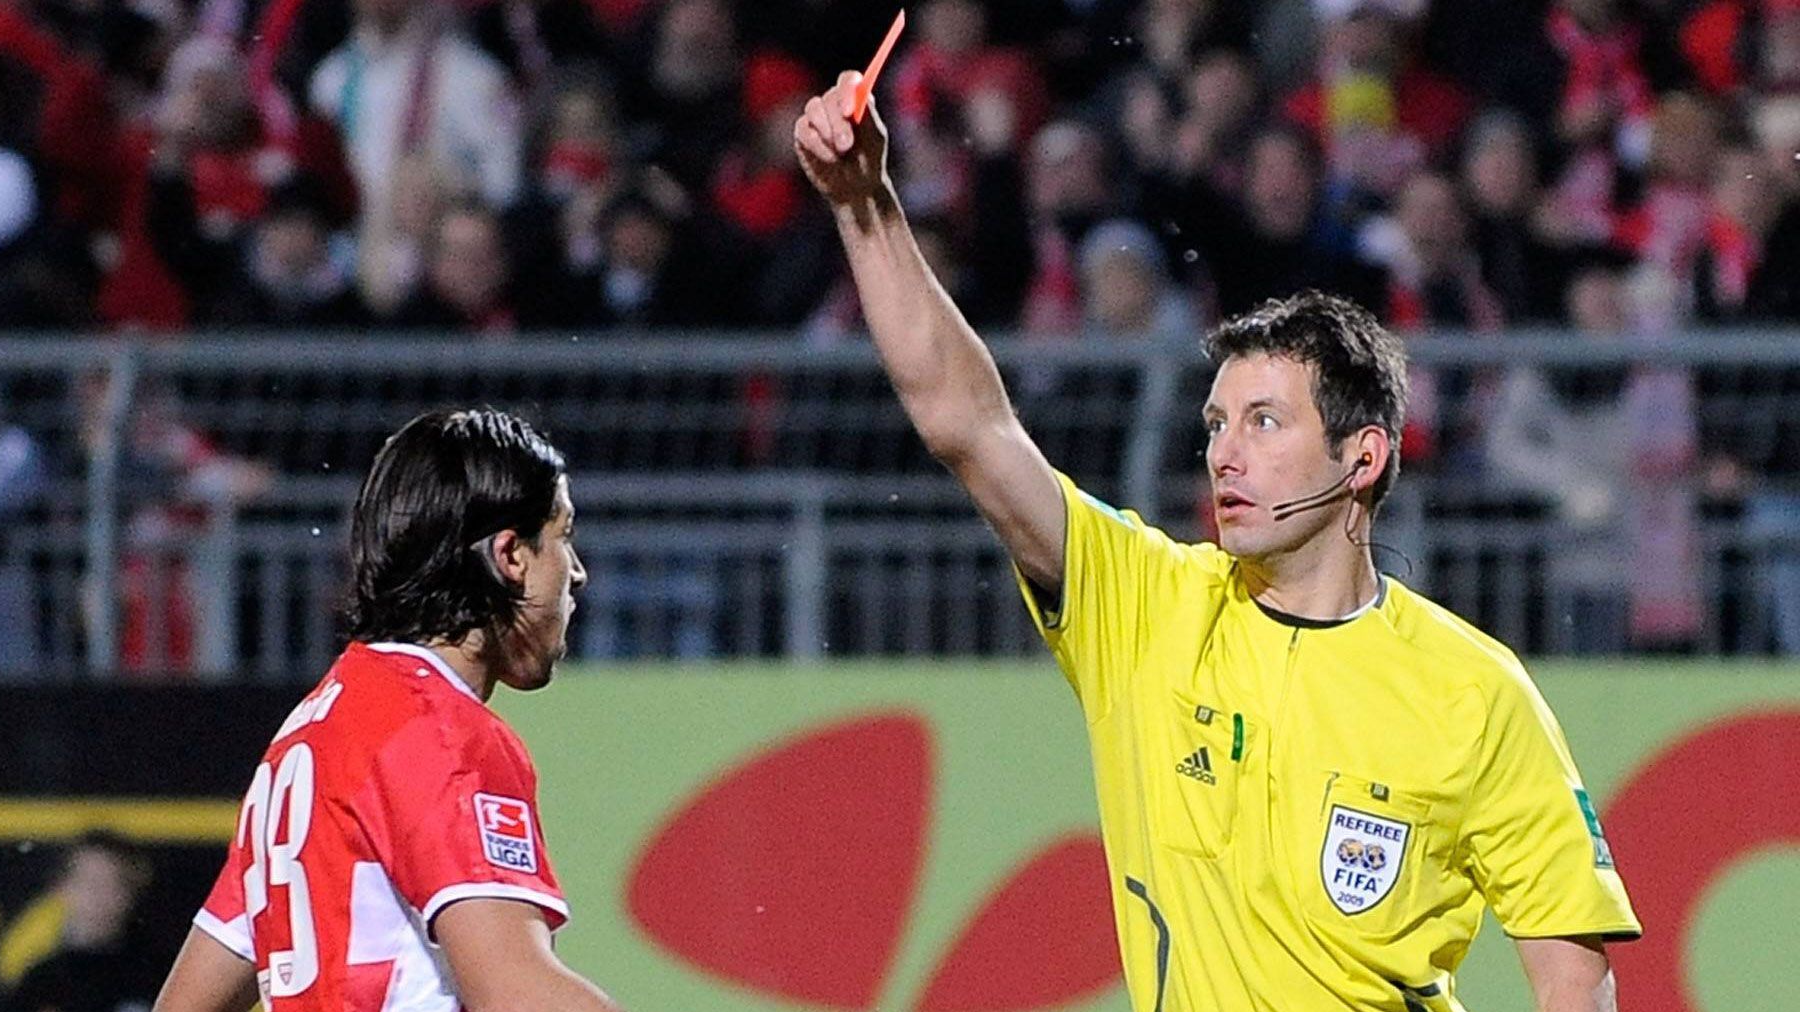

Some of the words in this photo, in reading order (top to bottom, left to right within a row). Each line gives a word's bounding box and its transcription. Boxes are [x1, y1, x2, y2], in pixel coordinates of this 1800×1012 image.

[1175, 763, 1216, 786] adidas
[1334, 813, 1404, 843] REFEREE
[488, 843, 535, 870] LIGA
[1333, 867, 1378, 894] FIFA
